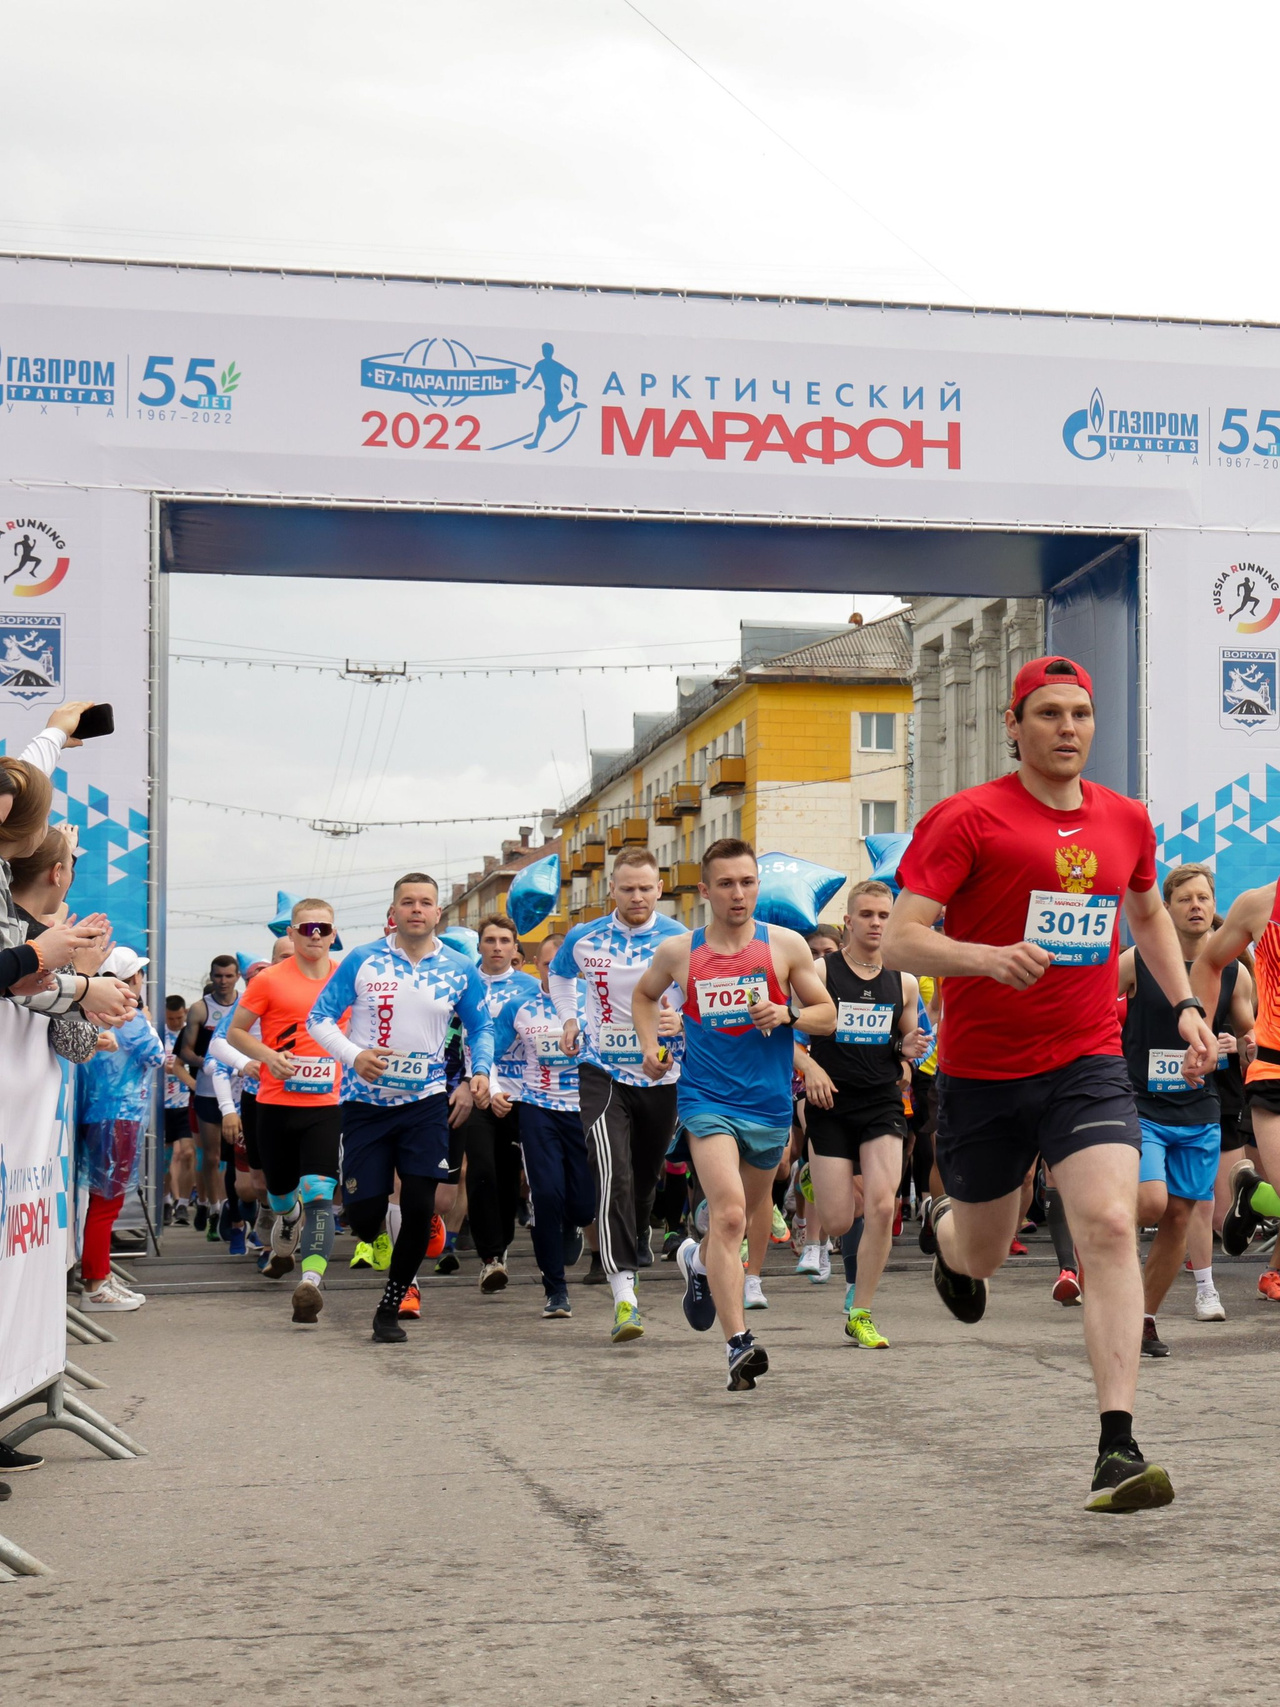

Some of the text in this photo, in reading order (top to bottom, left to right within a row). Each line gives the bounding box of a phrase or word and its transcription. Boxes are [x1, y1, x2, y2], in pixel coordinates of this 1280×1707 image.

[6, 355, 115, 387] ГАЗПРОМ
[374, 367, 504, 391] 67 ПАРАЛЛЕЛЬ
[137, 355, 217, 409] 55
[9, 386, 112, 403] ТРАНСГАЗ
[602, 371, 963, 412] АРКТИЧЕСКИЙ
[198, 395, 231, 410] ЛЕТ
[137, 407, 232, 424] 1967-2022
[1108, 410, 1199, 437] ГАЗПРОМ
[360, 410, 482, 451] 2022
[602, 405, 962, 470] МАРАФОН
[1111, 437, 1197, 452] ТРАНСГАЗ
[5, 518, 66, 550] RUNNING
[1213, 562, 1280, 615] RUSSIA RUNNING
[0, 616, 59, 625] ВОРКУТА
[1223, 650, 1275, 661] ВОРКУТА
[1098, 898, 1106, 907] 10
[1037, 910, 1108, 936] 3015
[584, 957, 612, 968] 2022
[366, 981, 399, 992] 2022
[705, 986, 759, 1008] 702
[367, 995, 377, 1050] ИЧЕСКИЙ
[377, 994, 395, 1048] АФОН
[843, 1013, 888, 1027] 3107
[525, 1025, 549, 1035] 2022
[541, 1041, 559, 1052] 31
[605, 1034, 637, 1047] 301
[293, 1064, 331, 1078] 7024
[1155, 1060, 1184, 1074] 30
